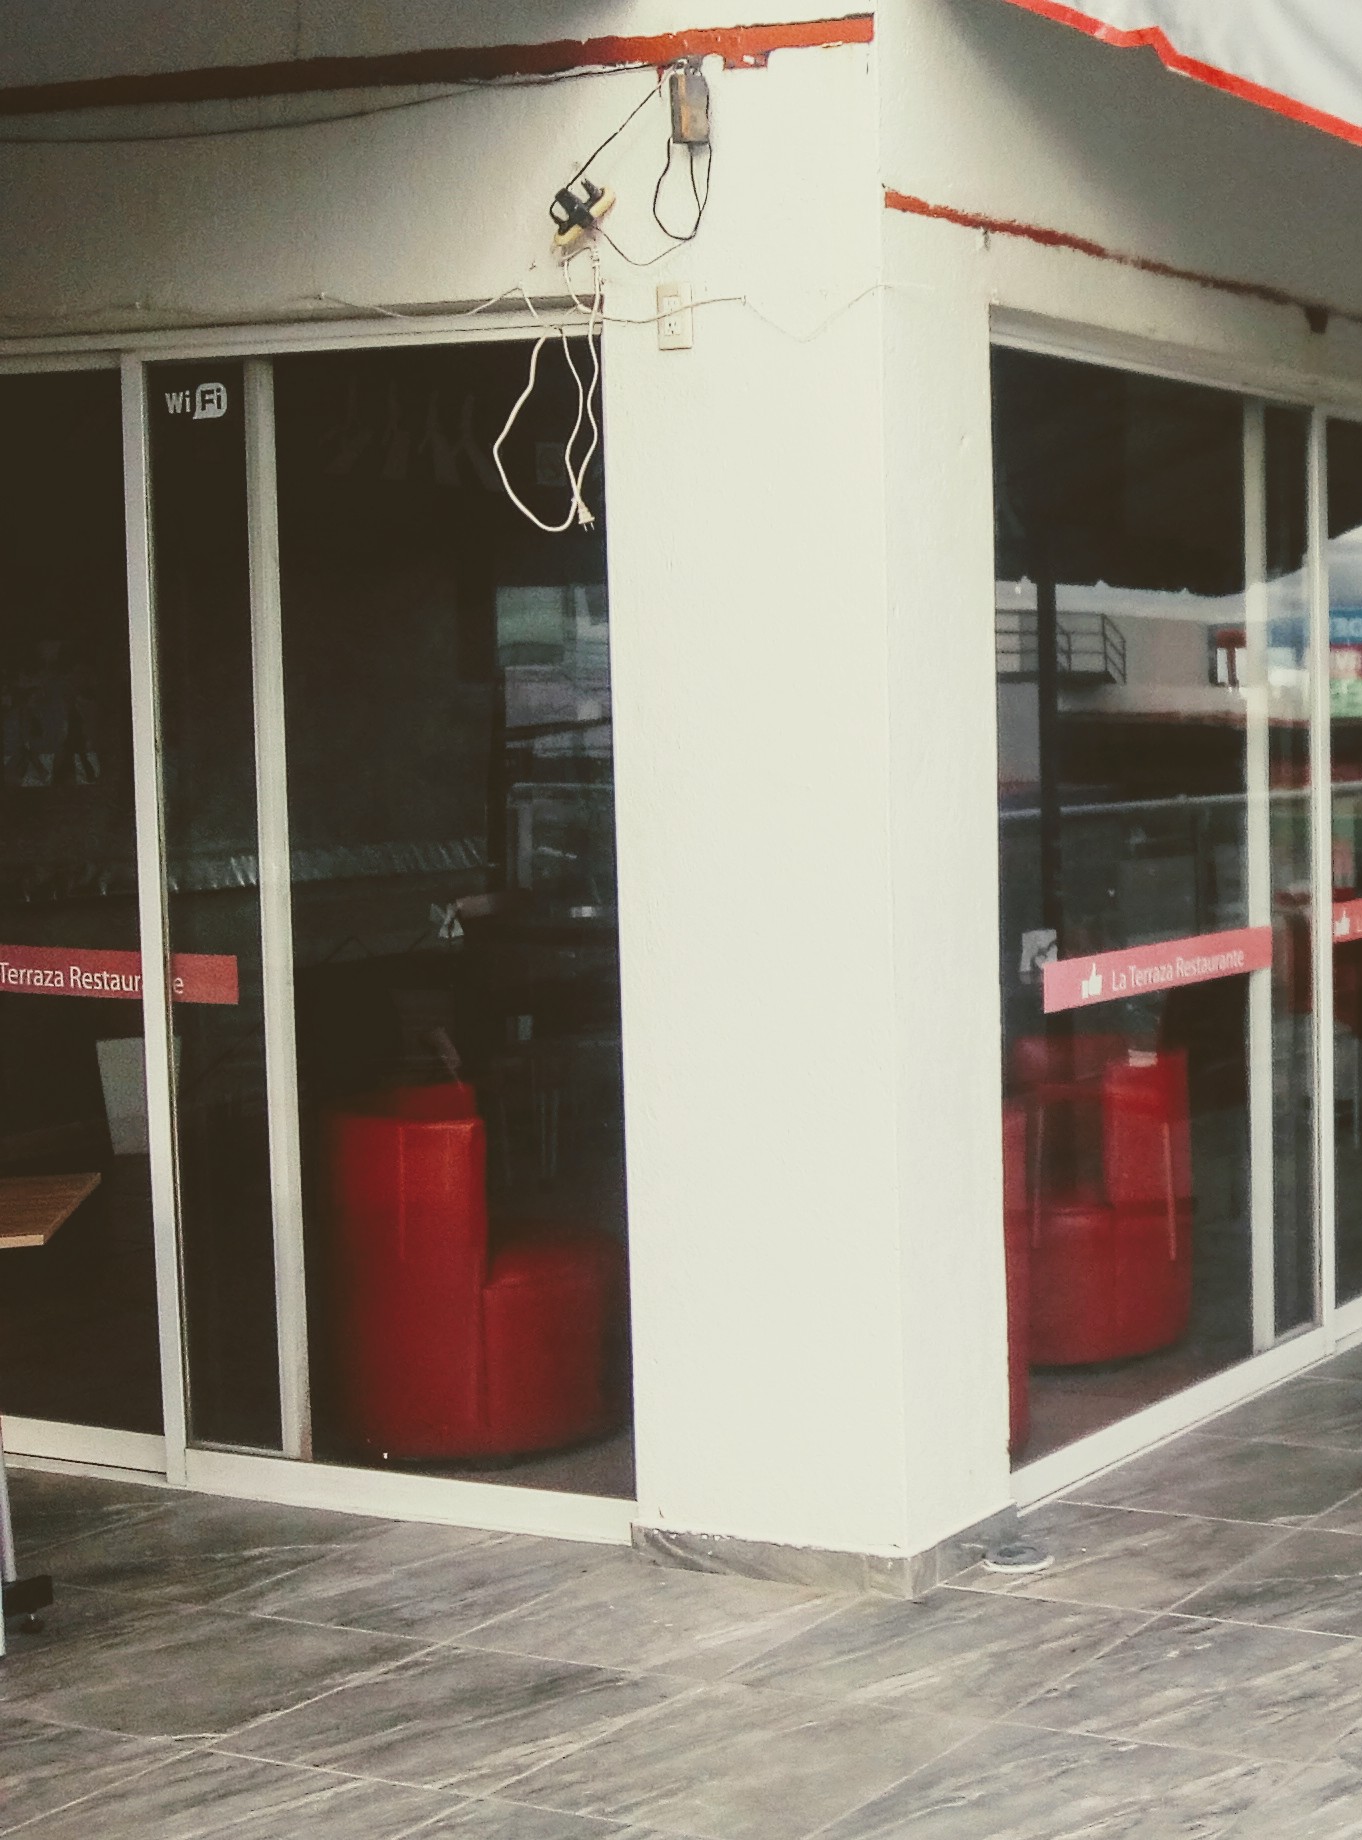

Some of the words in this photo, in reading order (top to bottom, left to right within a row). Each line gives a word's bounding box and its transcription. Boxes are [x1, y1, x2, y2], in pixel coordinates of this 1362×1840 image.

[0, 961, 65, 988] Terraza
[1112, 970, 1127, 992] La
[1130, 964, 1174, 987] Terraza
[1176, 949, 1245, 977] Restaurante
